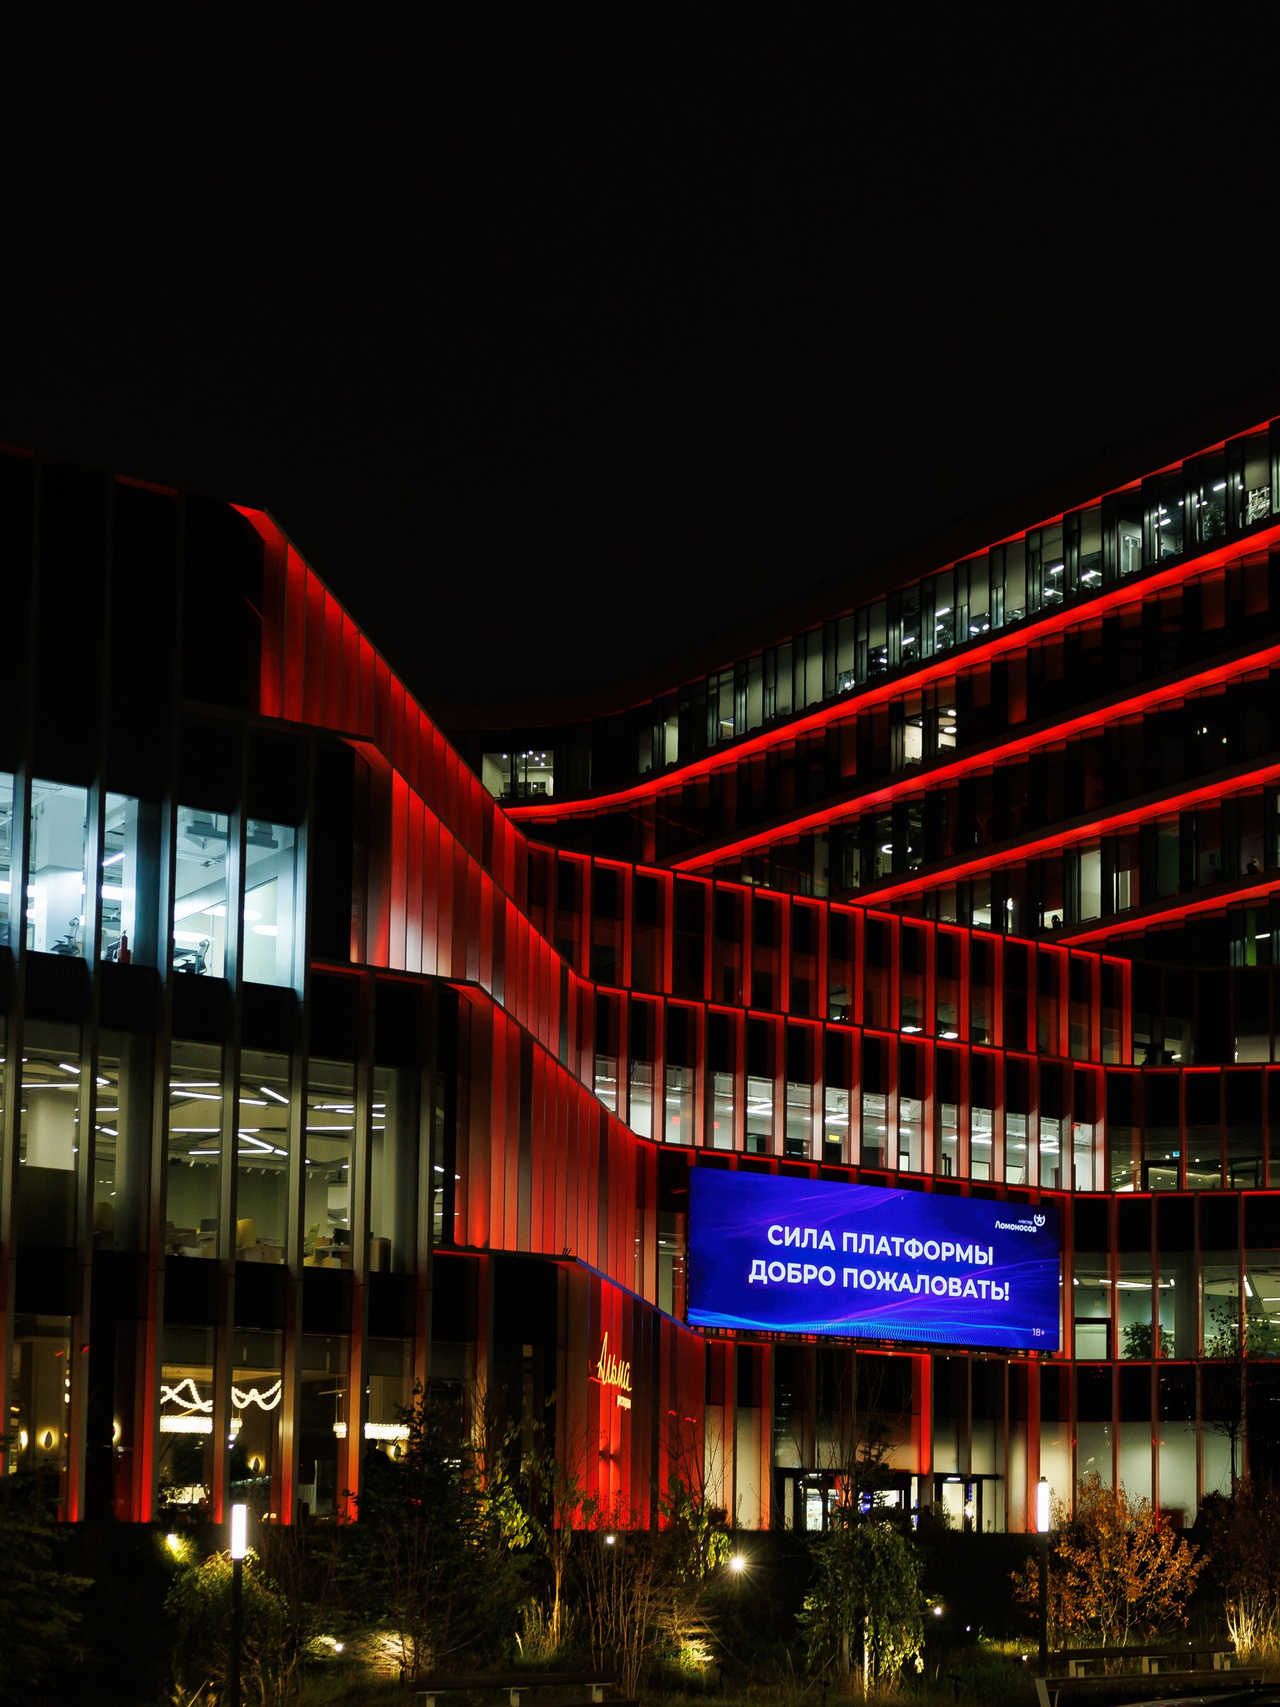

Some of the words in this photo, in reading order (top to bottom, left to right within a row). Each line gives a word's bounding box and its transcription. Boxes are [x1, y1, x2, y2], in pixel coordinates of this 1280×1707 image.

[995, 1220, 1037, 1233] Ломоносов
[767, 1224, 836, 1251] СИЛА
[842, 1232, 993, 1266] ПЛАТФОРМЫ
[748, 1259, 836, 1286] ДОБРО
[843, 1267, 1010, 1301] ПОЖАЛОВАТЬ!
[1032, 1328, 1046, 1337] 18+
